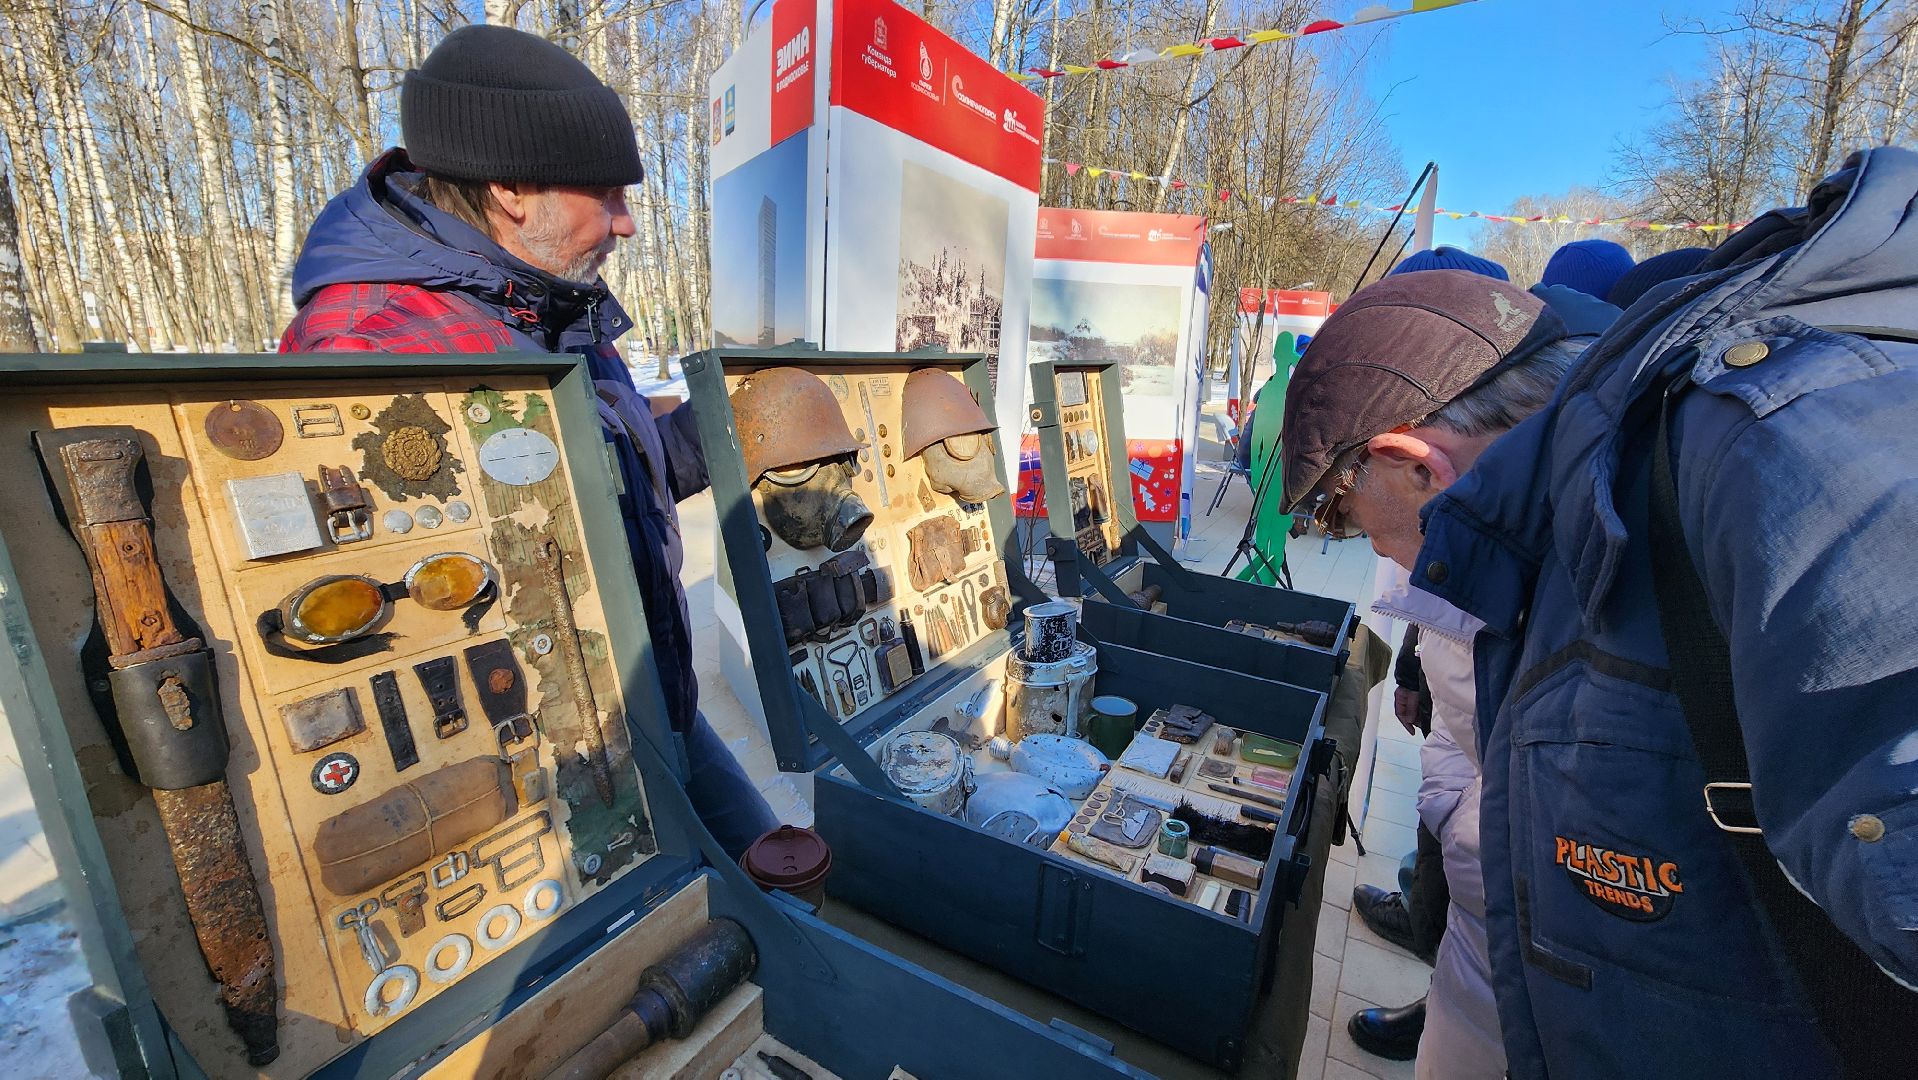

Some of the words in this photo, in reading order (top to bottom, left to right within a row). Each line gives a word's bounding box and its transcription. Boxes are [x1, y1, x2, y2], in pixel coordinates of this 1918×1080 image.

[776, 25, 810, 78] ЗИМА
[861, 53, 897, 78] губернатора
[867, 44, 892, 66] Команда
[1555, 835, 1684, 893] PLASTIC
[1583, 879, 1655, 913] TRENDS
